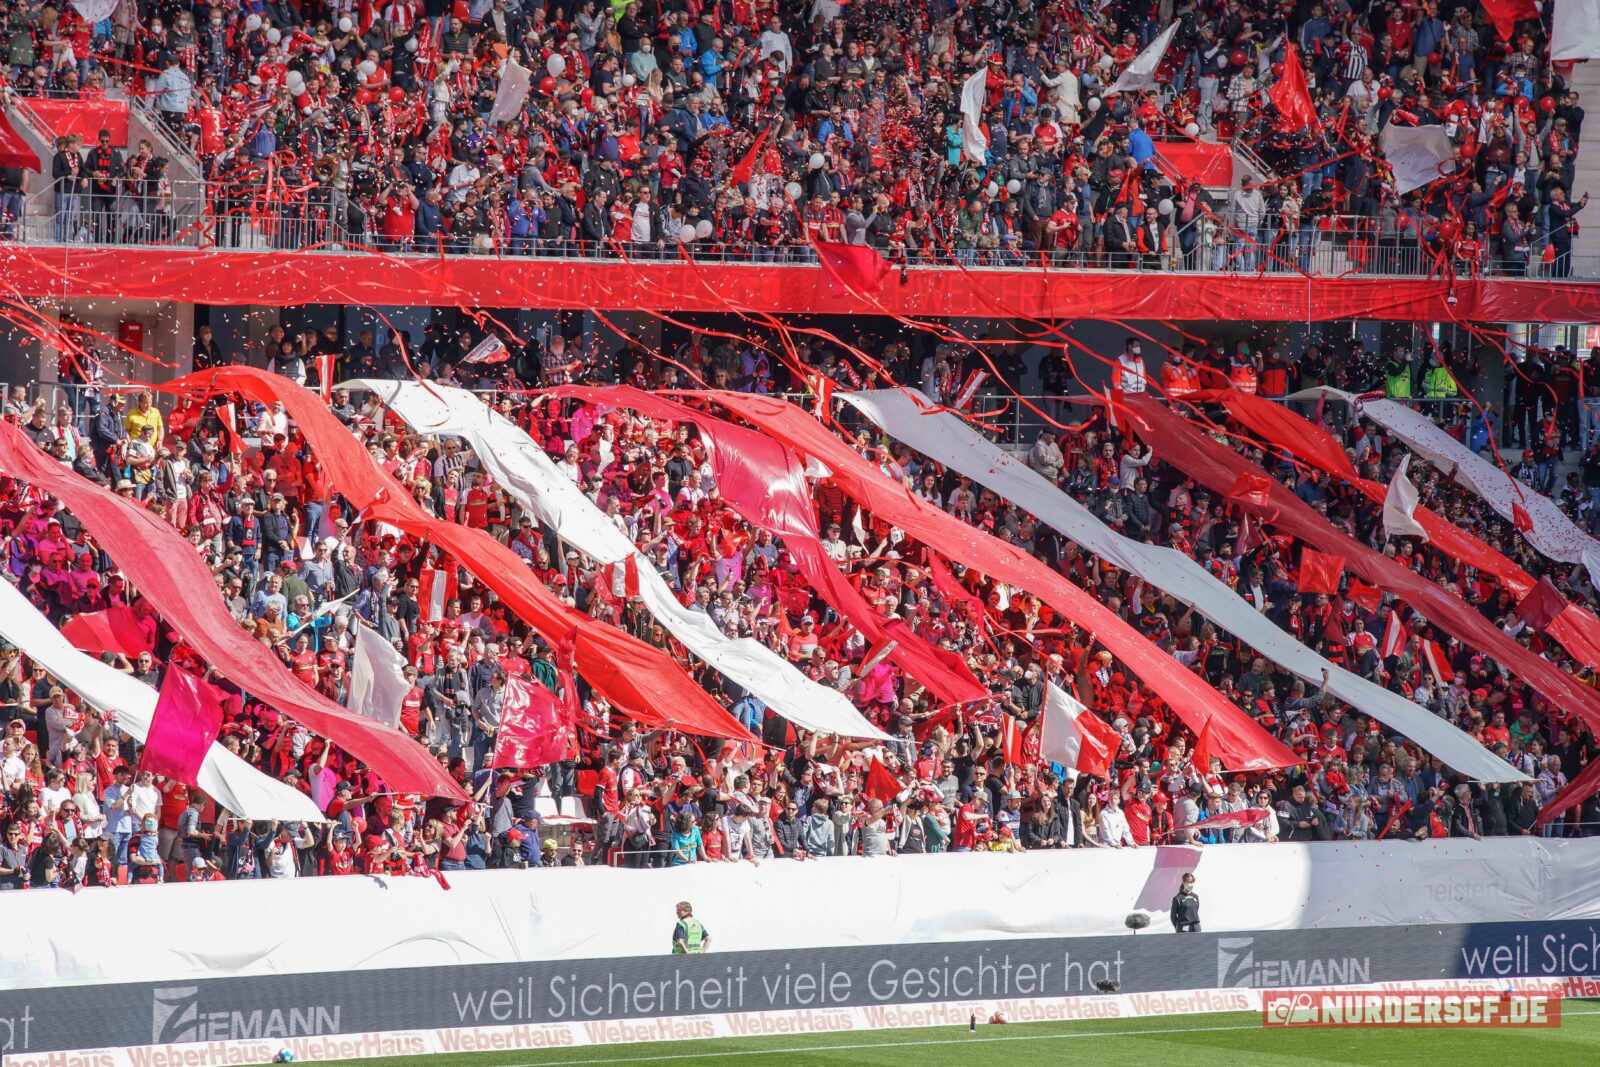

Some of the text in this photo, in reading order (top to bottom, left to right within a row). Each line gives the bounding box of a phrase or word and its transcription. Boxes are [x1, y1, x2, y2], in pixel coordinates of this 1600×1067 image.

[1461, 934, 1529, 975] weil
[452, 950, 1125, 1021] weil Sicherheit viele Gesichter hat
[863, 1003, 986, 1028] WeberHaus
[997, 997, 1120, 1021] WeberHaus
[1128, 990, 1249, 1015] WeberHaus
[584, 1017, 715, 1044] WeberHaus
[725, 1010, 853, 1035] WeberHaus
[284, 1033, 425, 1061] WeberHaus
[437, 1024, 574, 1052] WeberHaus
[127, 1041, 272, 1067] WeberHaus
